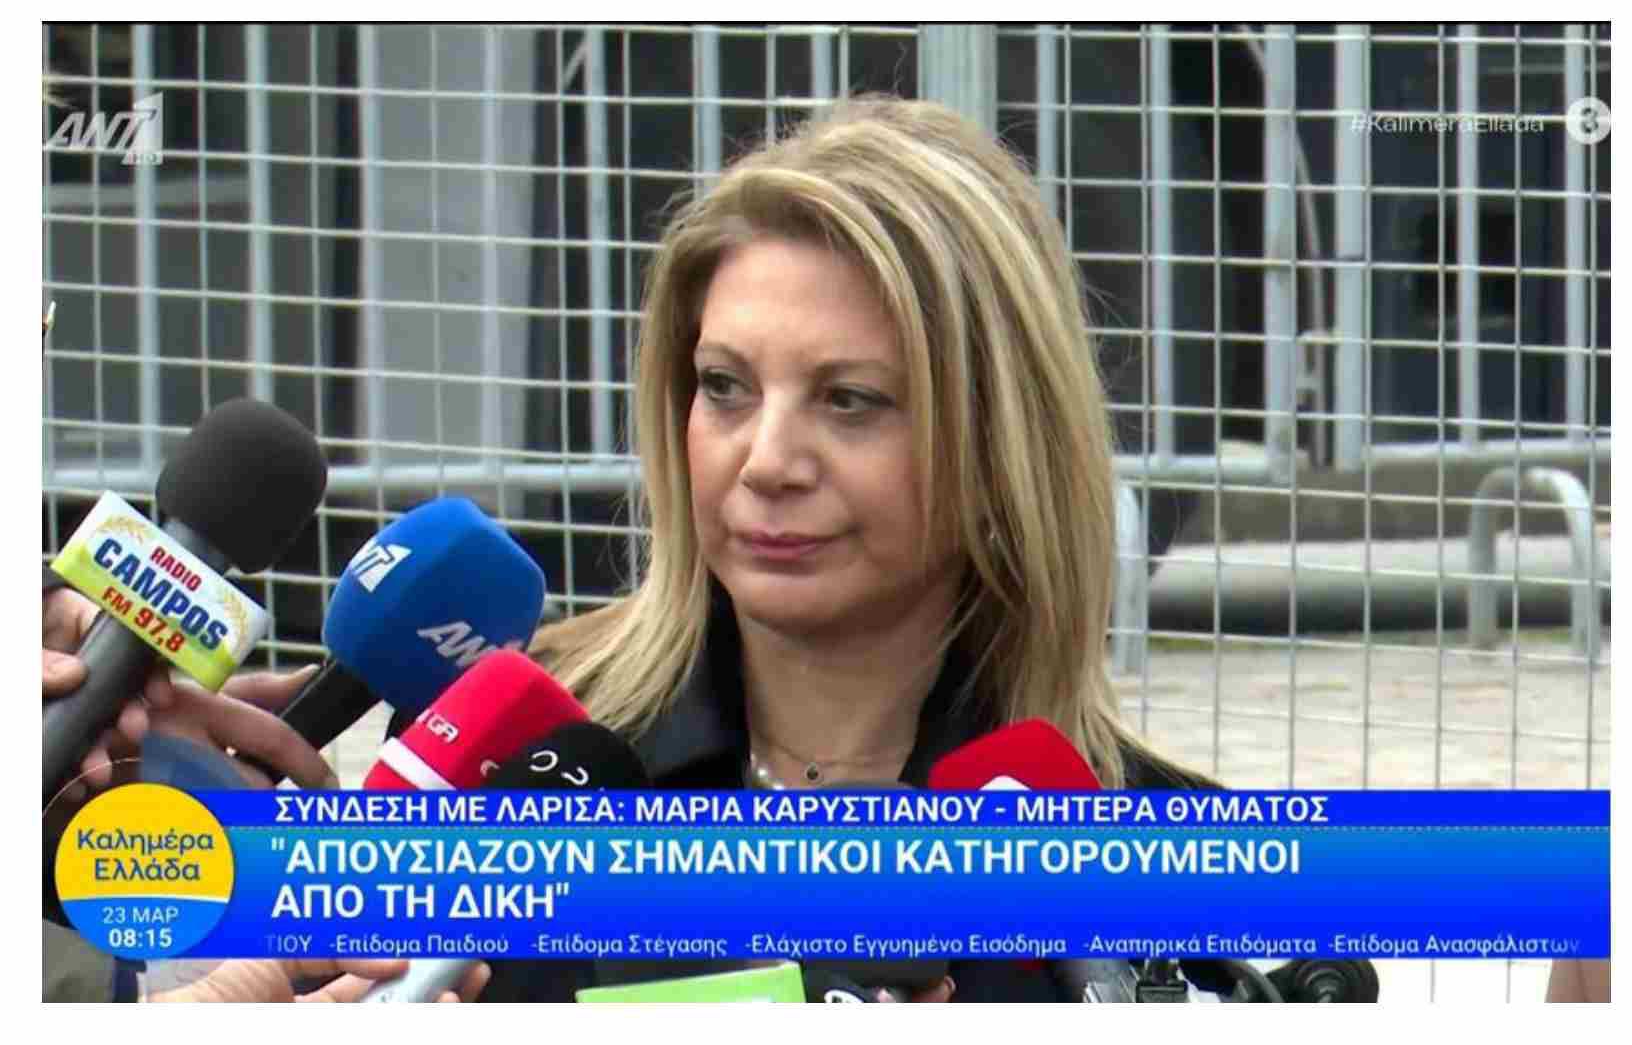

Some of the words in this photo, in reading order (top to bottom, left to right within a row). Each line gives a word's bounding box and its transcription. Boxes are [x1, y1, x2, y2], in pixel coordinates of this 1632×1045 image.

[93, 538, 229, 651] CAMPOS
[150, 545, 202, 592] RADIO
[101, 586, 134, 616] FM
[133, 607, 185, 652] 97,8
